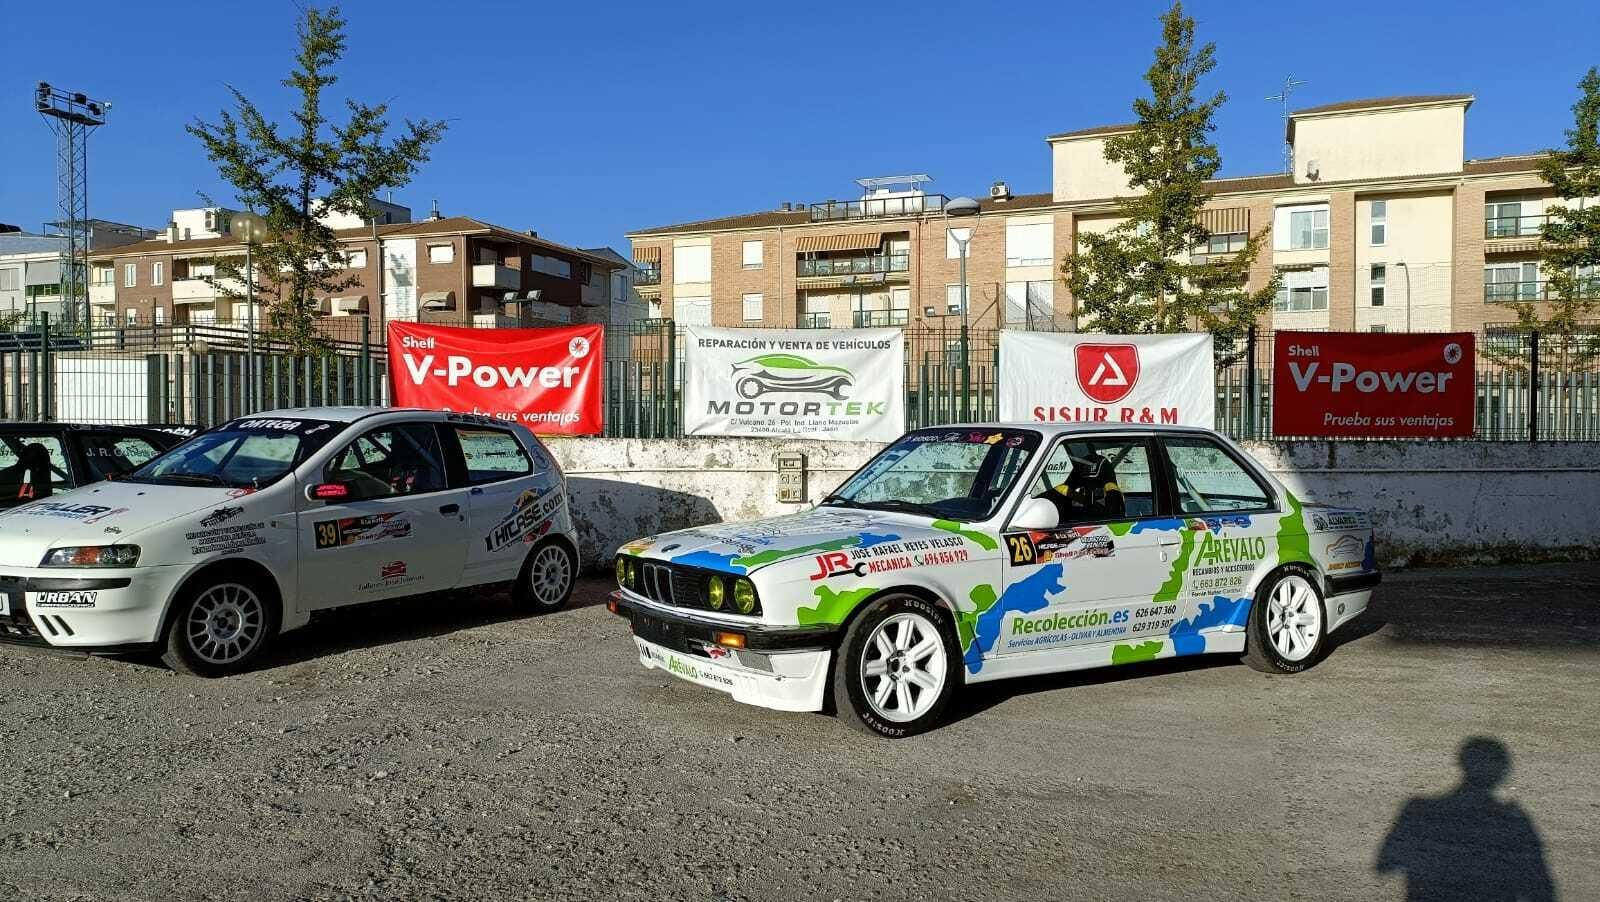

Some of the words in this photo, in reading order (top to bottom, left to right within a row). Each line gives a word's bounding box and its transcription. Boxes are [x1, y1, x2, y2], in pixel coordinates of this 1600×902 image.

[402, 336, 435, 349] Shell
[698, 337, 767, 349] REPARACIÓN
[769, 341, 776, 349] Y
[779, 341, 813, 350] VENTA
[816, 341, 830, 350] DE
[832, 339, 891, 350] VEHÍCULOS
[1288, 345, 1320, 357] Shell
[402, 353, 580, 388] V-Power
[1288, 362, 1453, 393] V-Power
[706, 400, 886, 416] MOTORTEK
[1033, 406, 1109, 423] SISUR
[1120, 407, 1178, 424] R&M
[239, 419, 303, 431] ORTEGA
[495, 412, 518, 421] sus
[522, 410, 580, 426] ventajas
[1323, 411, 1371, 426] Prueba
[1374, 416, 1395, 426] sus
[1401, 413, 1454, 430] ventajas
[318, 523, 336, 546] 39
[851, 549, 872, 560] JOSE
[873, 544, 902, 556] RAFAEL
[905, 540, 929, 552] REYES
[930, 536, 964, 549] VELASCO
[1010, 536, 1033, 562] 26
[1194, 531, 1266, 567] ARÉVALO
[810, 552, 852, 580] JR
[868, 556, 912, 573] MECANICA
[924, 553, 939, 566] 696
[940, 551, 953, 564] 856
[954, 549, 969, 562] 929
[1193, 566, 1220, 576] RECAMBIOS
[1200, 579, 1213, 589] 663
[1215, 578, 1228, 587] 872
[1229, 576, 1242, 586] 826
[36, 591, 97, 604] URBAN
[1135, 607, 1149, 618] 626
[1150, 606, 1162, 617] 647
[1163, 604, 1177, 615] 360
[1012, 608, 1129, 635] Recolección.es
[1132, 622, 1146, 633] 629
[1146, 620, 1160, 631] 319
[1161, 618, 1174, 629] 507
[1008, 639, 1034, 648] Servicios
